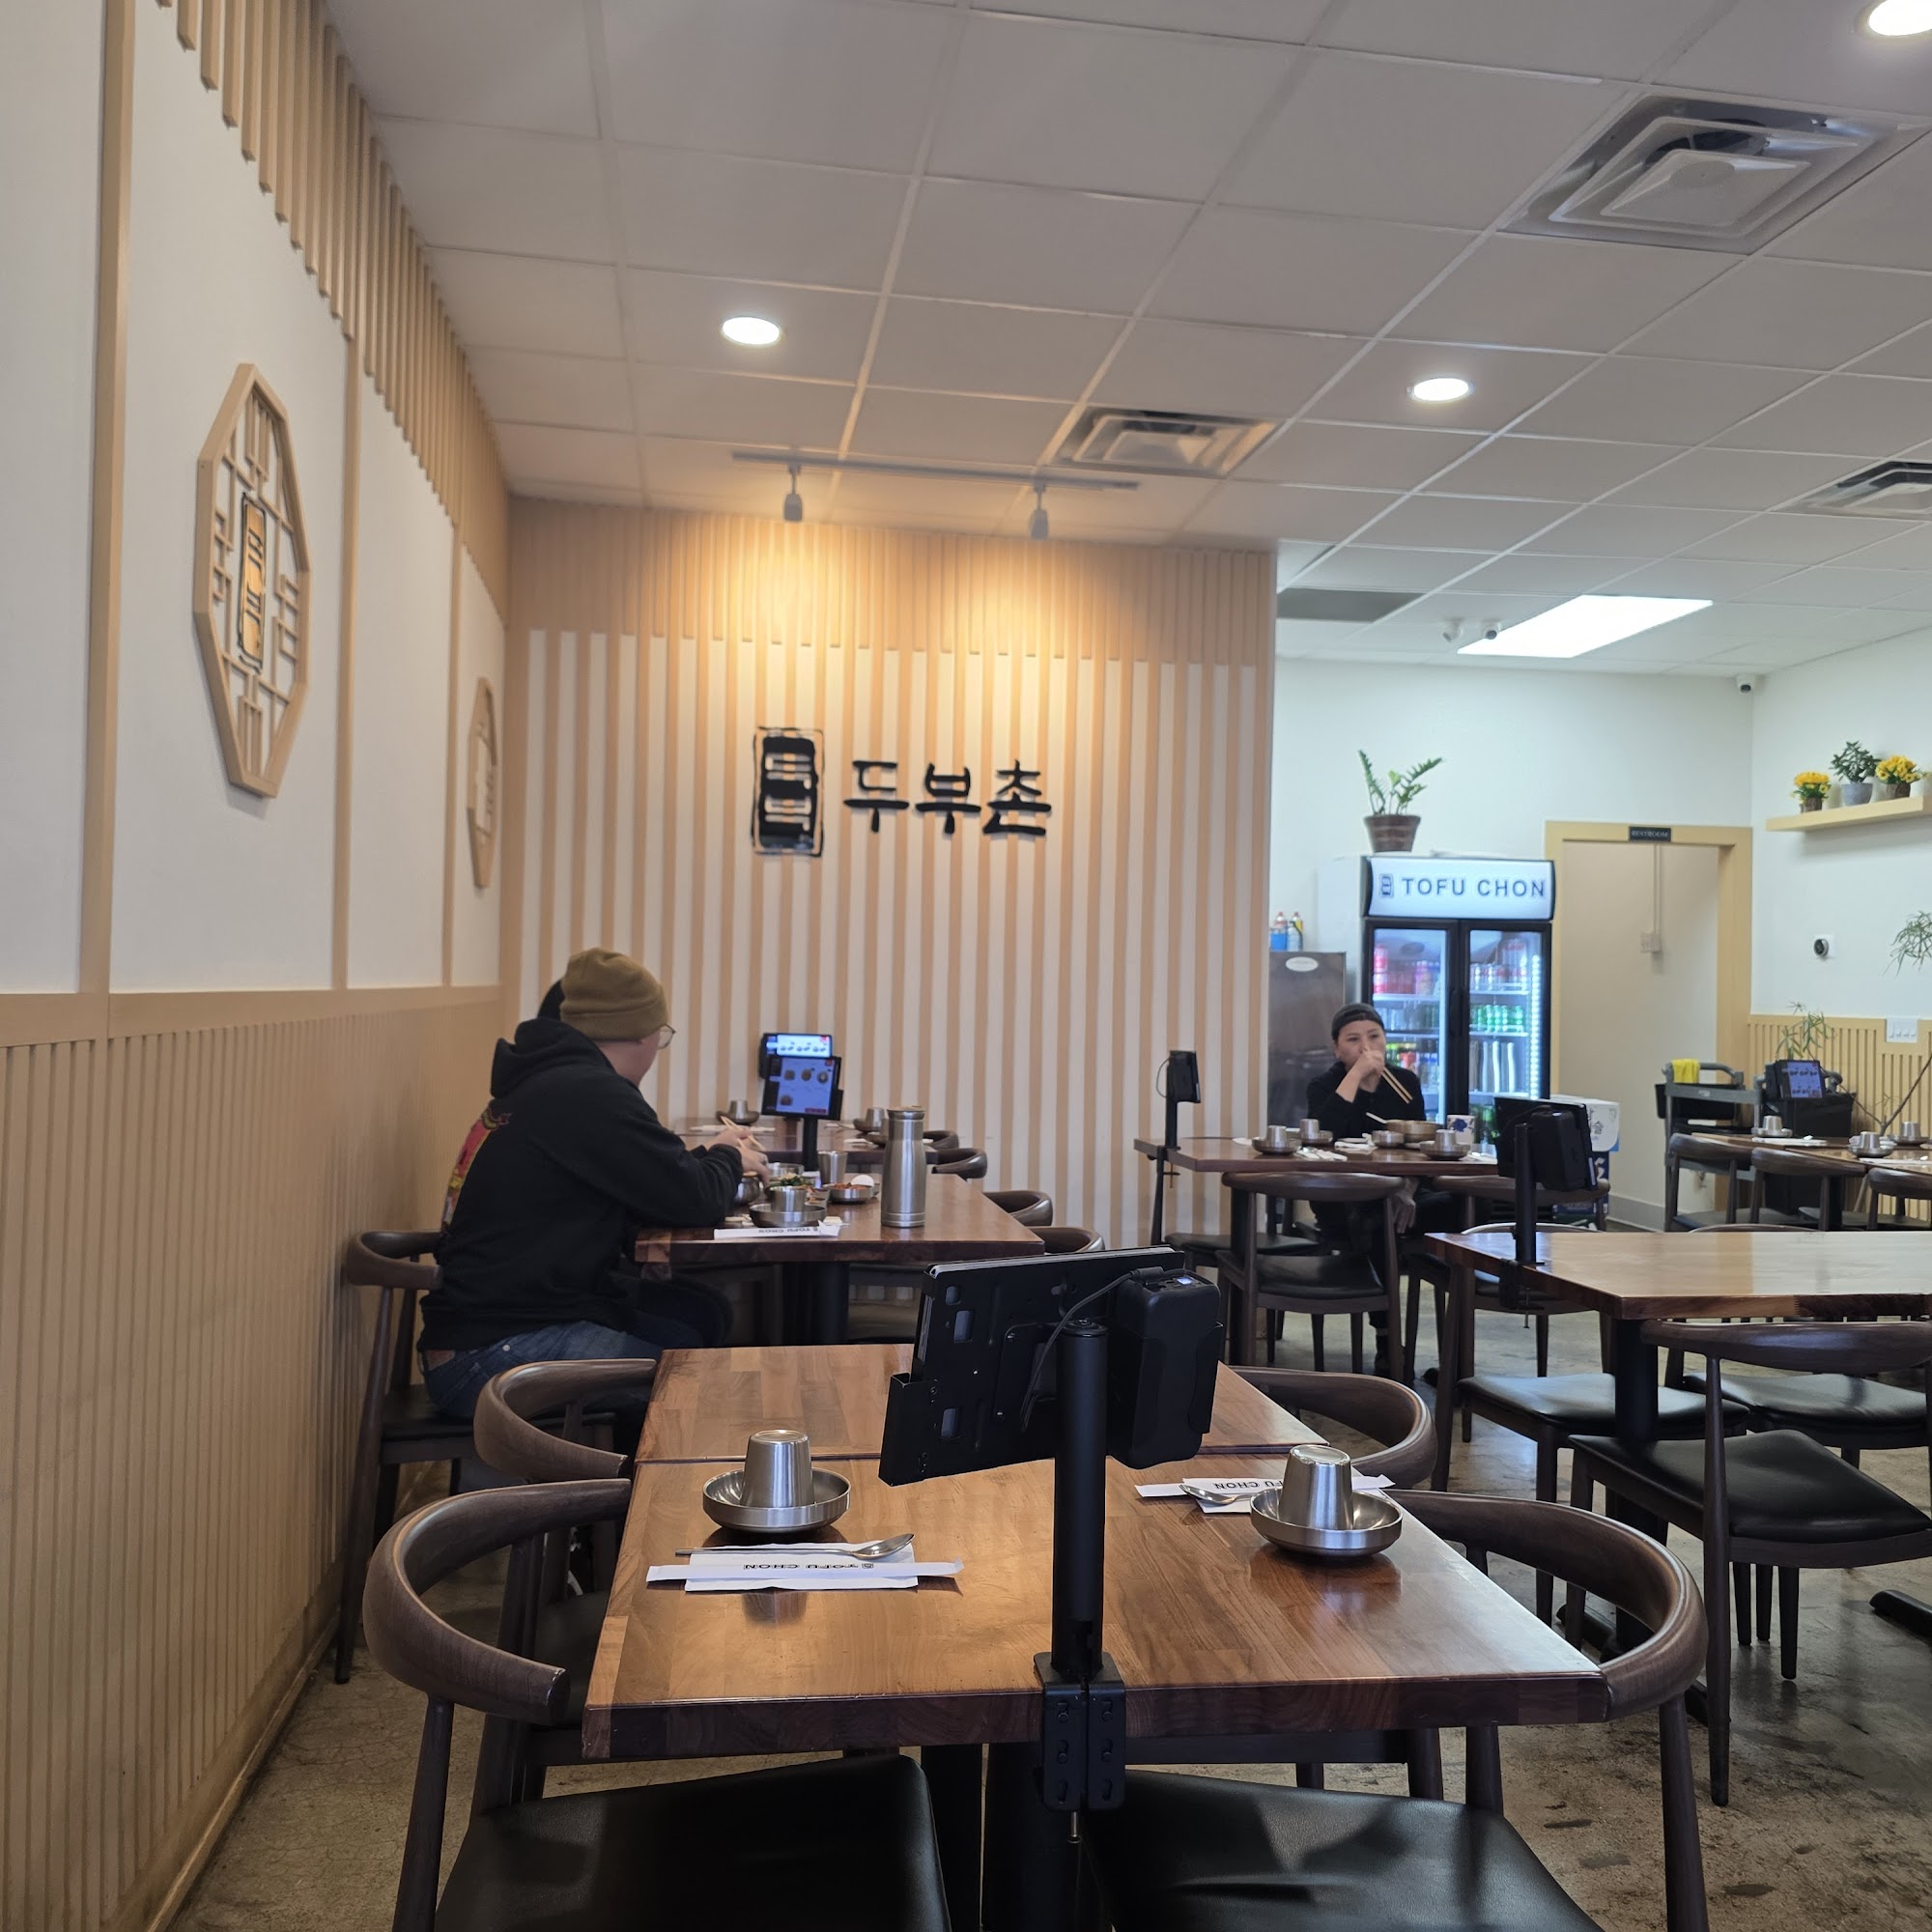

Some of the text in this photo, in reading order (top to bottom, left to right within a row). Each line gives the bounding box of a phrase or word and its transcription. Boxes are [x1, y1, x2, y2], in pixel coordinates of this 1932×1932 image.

[842, 759, 1052, 837] 두부촌
[1402, 877, 1465, 896] TOFU
[1477, 879, 1546, 897] CHON
[1214, 1481, 1260, 1490] CHON
